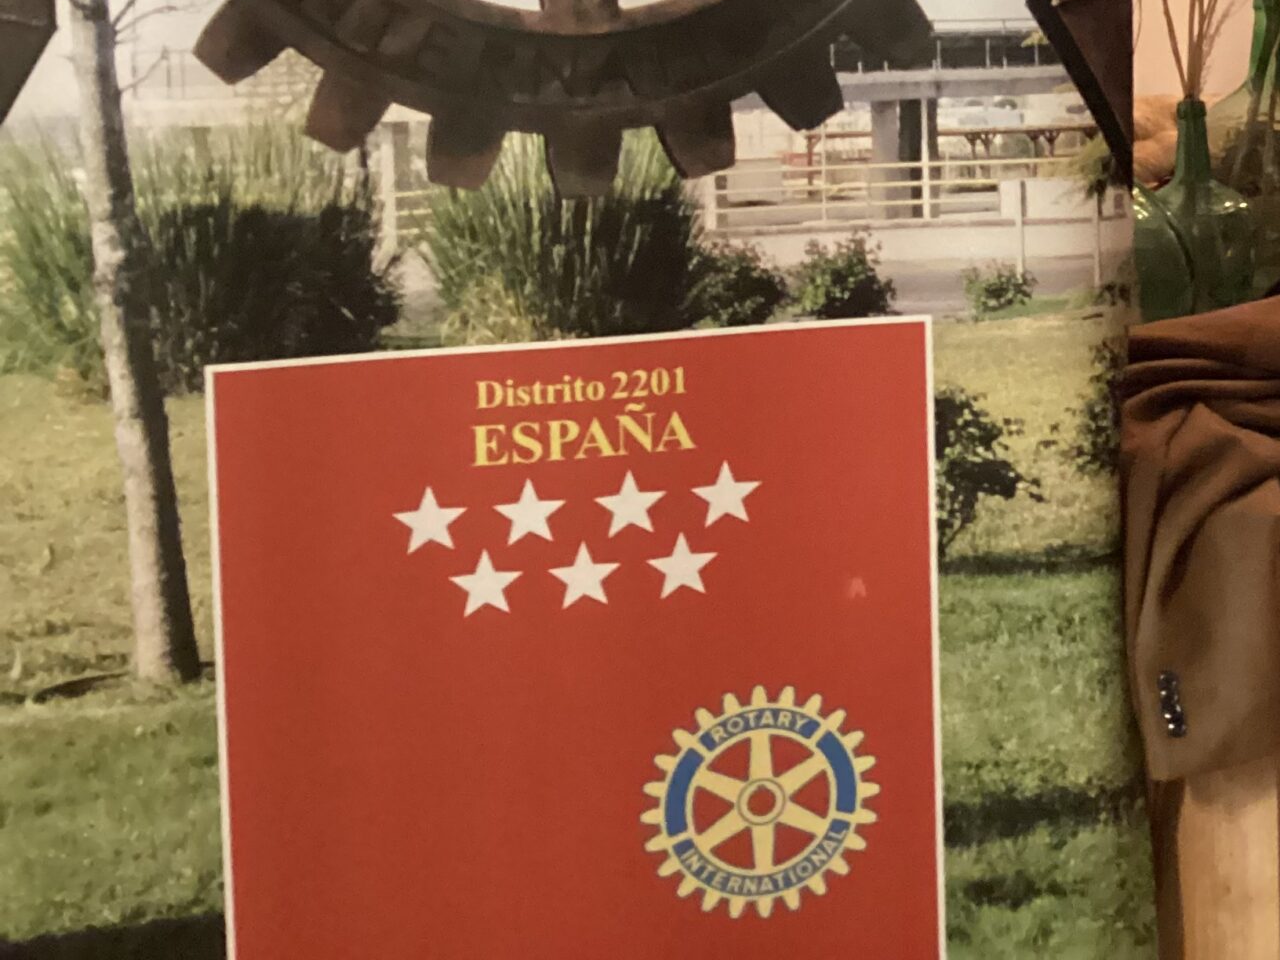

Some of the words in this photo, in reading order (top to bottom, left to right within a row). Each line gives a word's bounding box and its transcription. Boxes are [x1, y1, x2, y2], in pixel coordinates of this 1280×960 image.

[475, 374, 606, 410] Distrito
[610, 365, 687, 400] 2201
[471, 401, 697, 467] ESPAÑA
[709, 709, 809, 745] ROTARY
[680, 828, 850, 895] INTERNATIONAL
